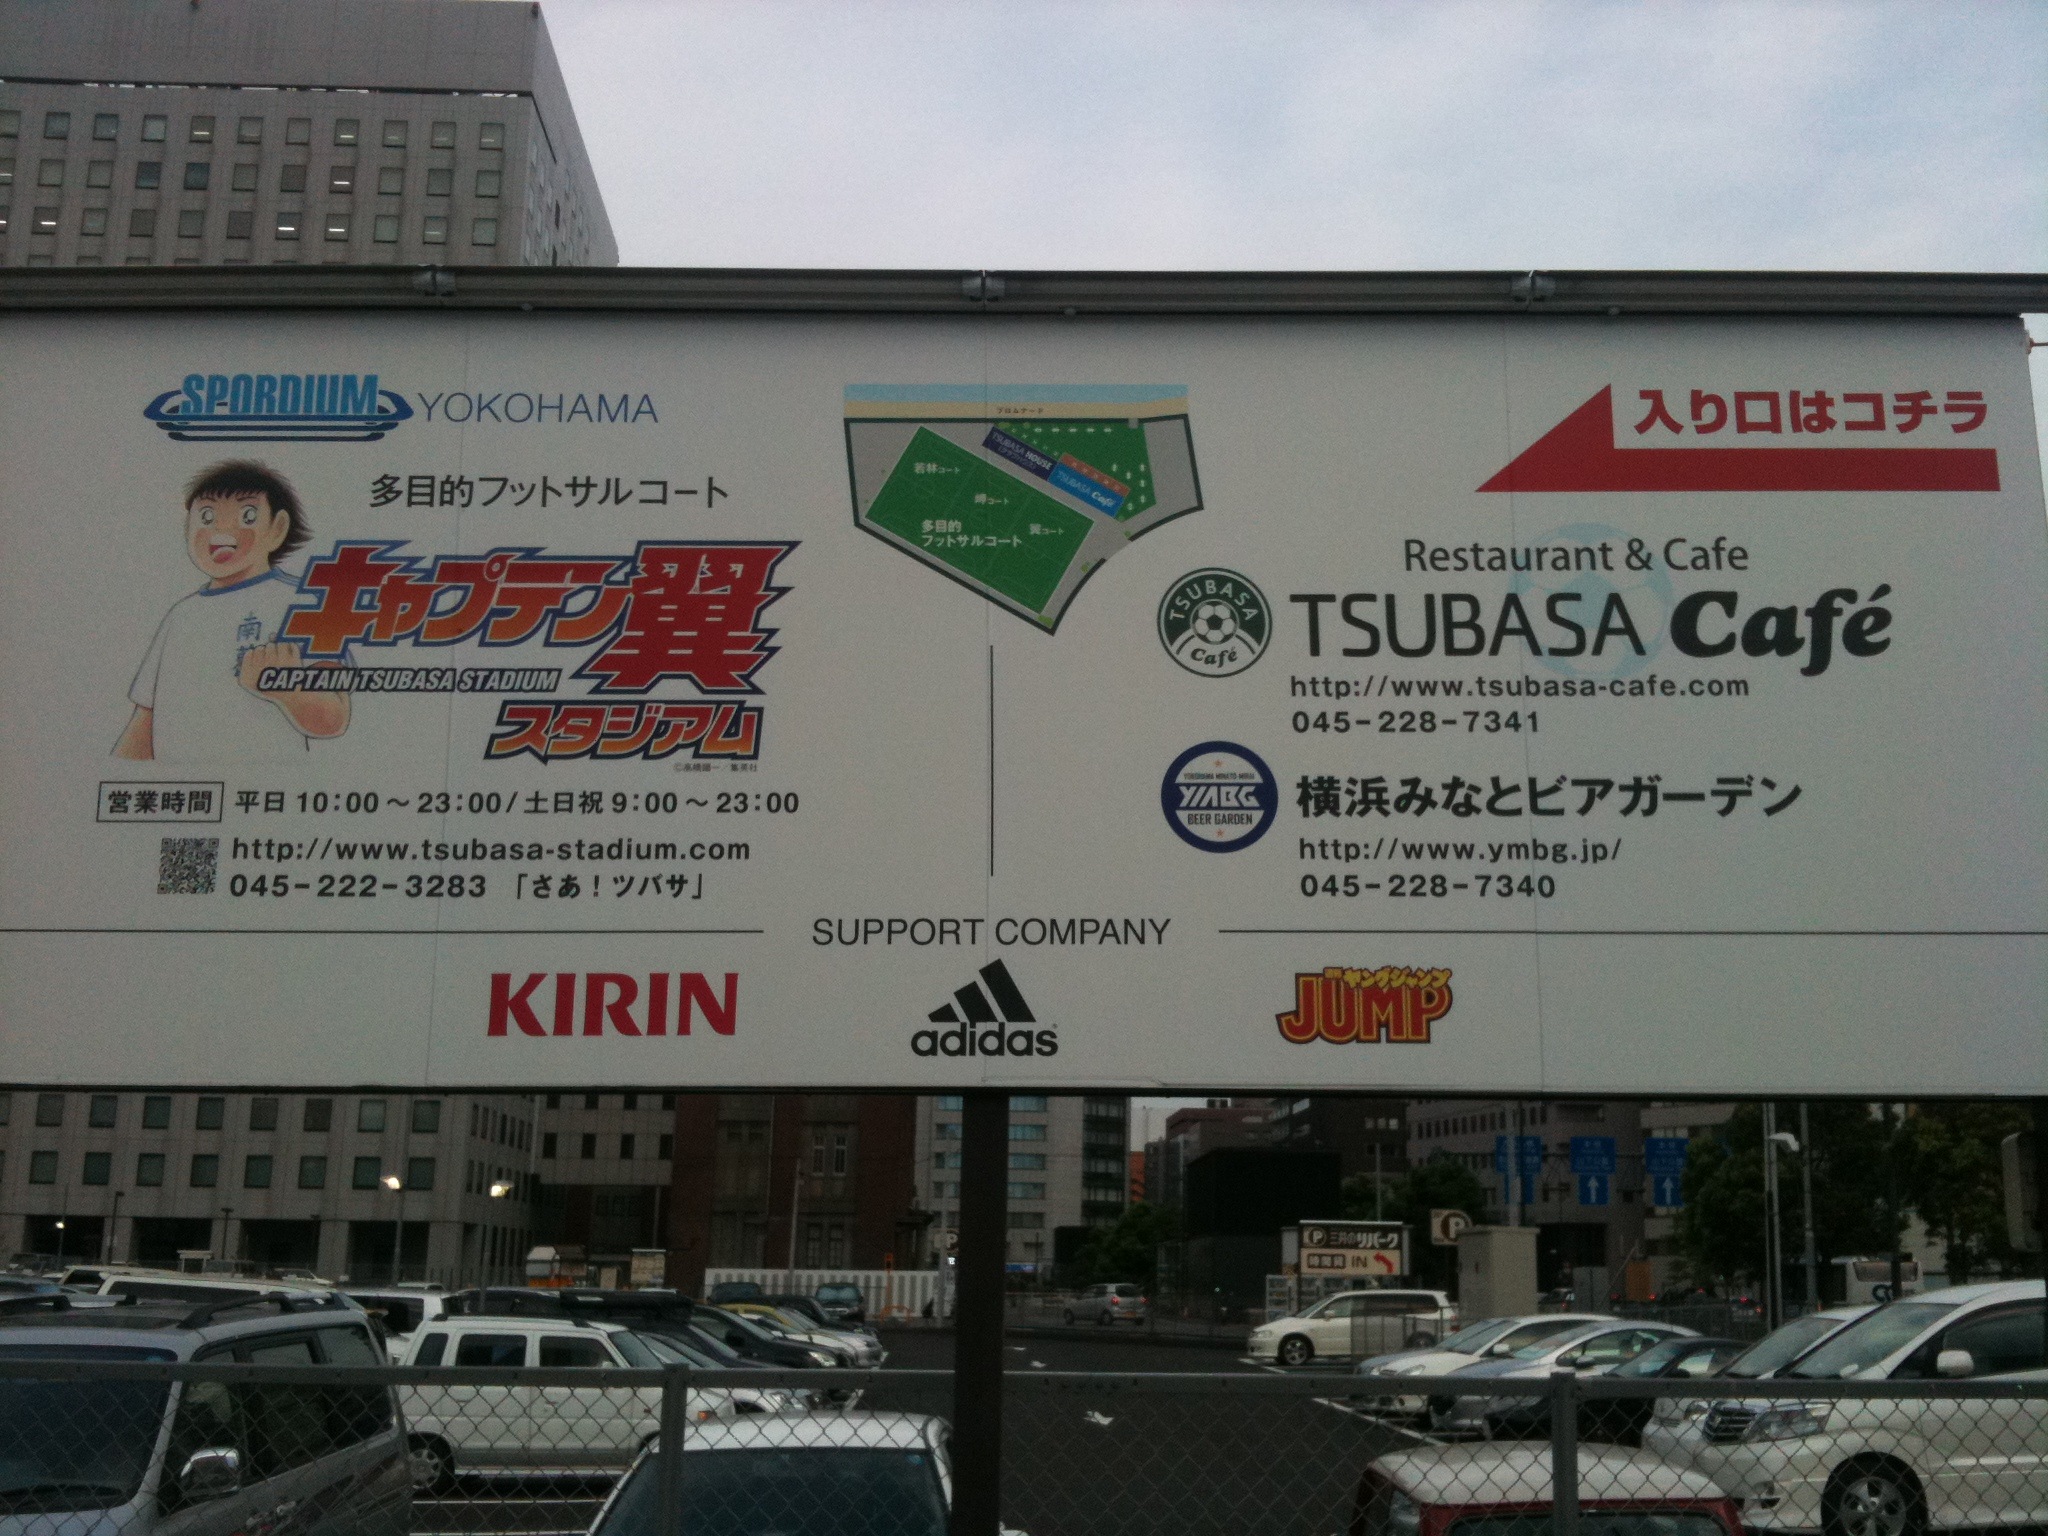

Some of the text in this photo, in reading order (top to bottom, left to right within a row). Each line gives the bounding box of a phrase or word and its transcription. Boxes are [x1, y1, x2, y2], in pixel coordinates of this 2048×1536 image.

[180, 373, 660, 424] SPORDIUM YOKOHAMA
[1633, 388, 1988, 435] 入り口はコチラ
[370, 474, 730, 510] 多目的フットサルコート
[920, 519, 962, 534] 多目的
[921, 534, 1022, 548] フットサルコート
[1404, 536, 1749, 573] Restaurant & Cafe
[1169, 579, 1259, 621] TSUBASA
[286, 540, 799, 696] キャプテン翼
[1290, 583, 1893, 676] TSUBASA Café
[1190, 645, 1239, 668] Café
[257, 667, 562, 692] CAPTAIN TSUBASA STADIUM
[1290, 674, 1750, 701] http://www.tsubasa-cafe.com
[484, 700, 764, 764] スタジアム
[1291, 710, 1541, 734] 045-228-7341
[108, 790, 213, 814] 営業時間
[235, 791, 286, 815] 平日
[1296, 774, 1802, 820] 横浜みなとビアガーデン
[1187, 813, 1253, 826] BEER GARDEN
[231, 836, 751, 863] http://www.tsubasa-stadium.com
[1299, 837, 1622, 865] http://www.ymbg.jp/
[230, 875, 486, 900] 045-222-3283
[1300, 874, 1557, 899] 045-228-7340
[812, 917, 1172, 946] SUPPORT COMPANY
[487, 972, 739, 1037] KIRIN
[1275, 973, 1453, 1044] JUMP
[911, 1022, 1059, 1057] adidas
[1351, 1255, 1368, 1268] IN
